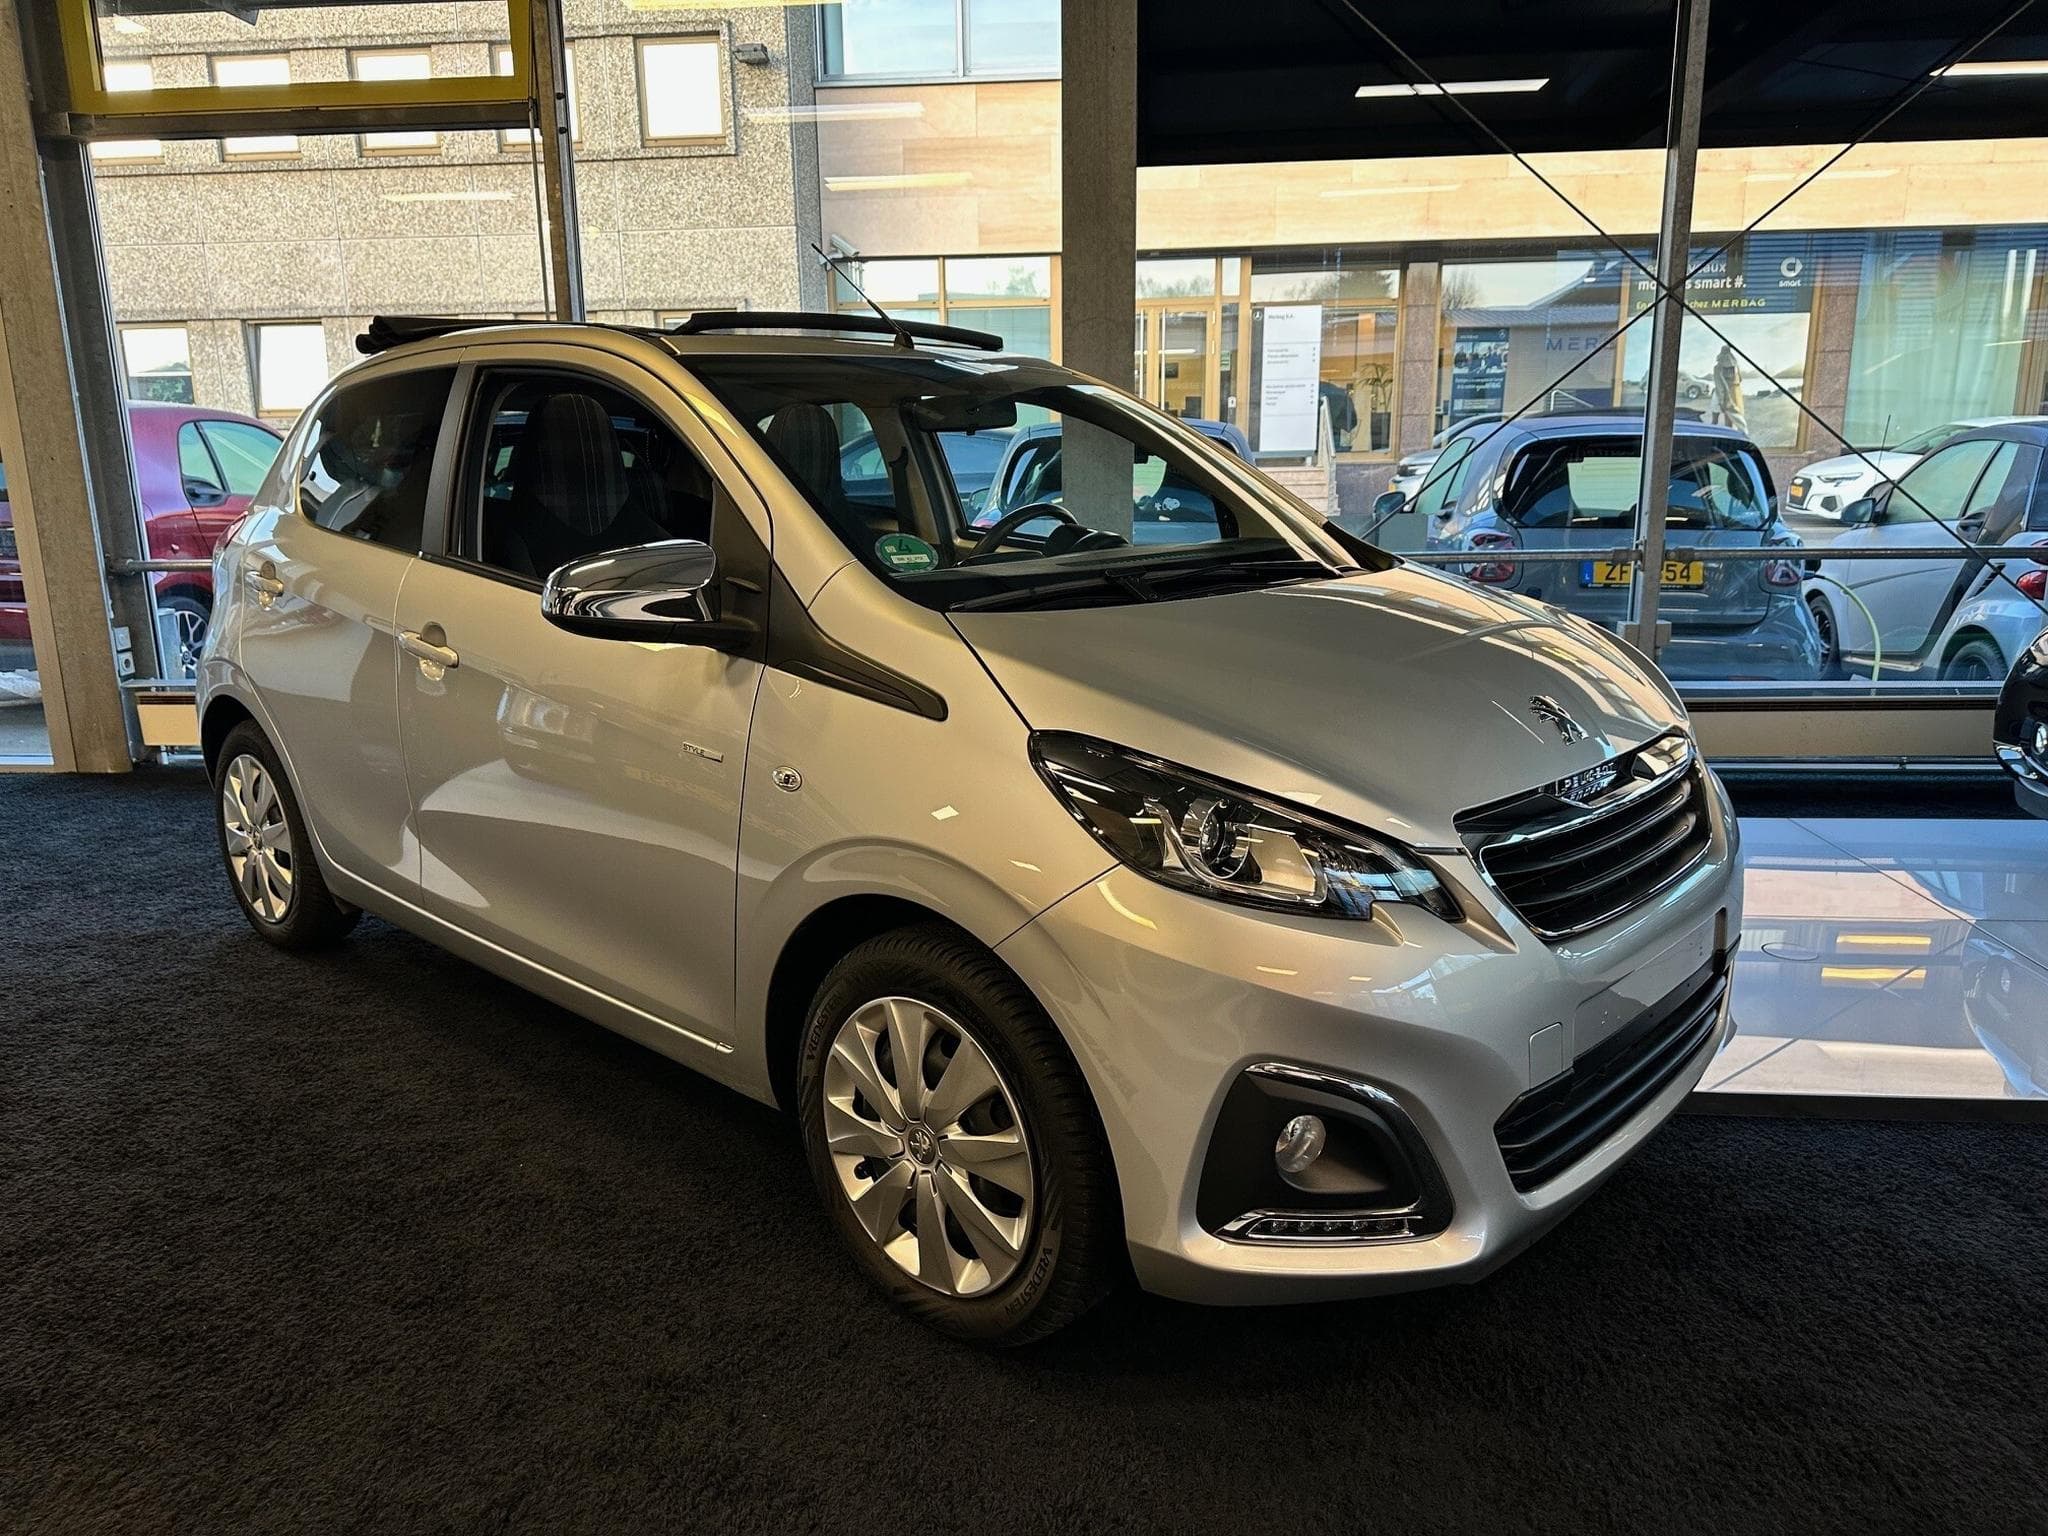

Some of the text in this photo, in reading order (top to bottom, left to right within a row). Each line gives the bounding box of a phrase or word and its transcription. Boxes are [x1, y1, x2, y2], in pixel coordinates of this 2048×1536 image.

[1694, 276, 1733, 290] smart
[1778, 279, 1802, 288] smart
[1711, 298, 1767, 309] MERBAG
[899, 539, 912, 553] 4
[683, 743, 705, 757] STYLE
[1563, 762, 1615, 788] PEUGEOT
